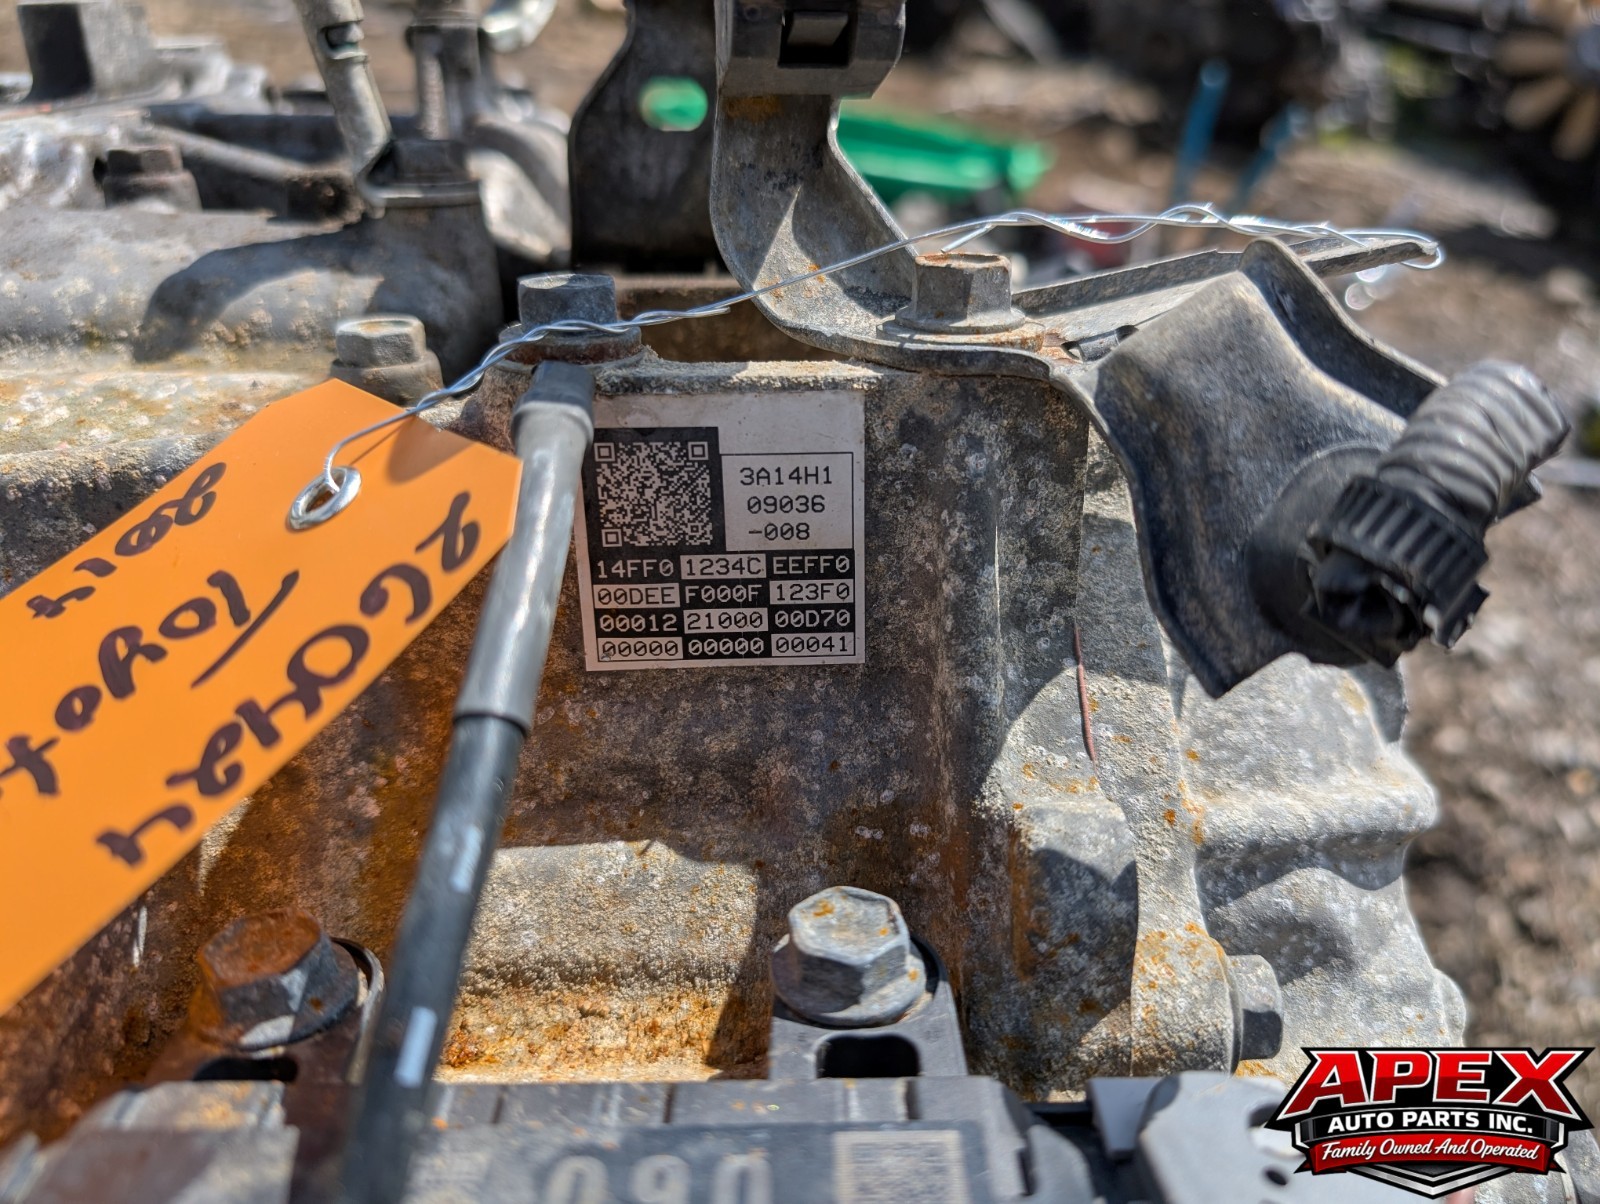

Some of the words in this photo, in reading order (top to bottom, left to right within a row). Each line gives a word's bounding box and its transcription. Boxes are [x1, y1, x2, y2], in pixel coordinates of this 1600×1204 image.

[739, 465, 833, 486] 3A14H1
[747, 495, 826, 515] 09036
[748, 522, 811, 541] -008
[597, 559, 675, 579] 14FF0
[685, 557, 763, 577] 1234C
[773, 555, 851, 574] EEFF0
[597, 585, 676, 605] 00DEE
[684, 583, 763, 604] F000F
[775, 580, 851, 601] 123F0
[599, 613, 678, 632] 00012
[686, 610, 764, 630] 21000
[774, 608, 851, 628] 00D70
[601, 640, 679, 658] 00000
[687, 637, 765, 656] 00000
[775, 635, 849, 654] 00041
[0, 569, 299, 797] Toyot
[96, 490, 481, 868] 260424
